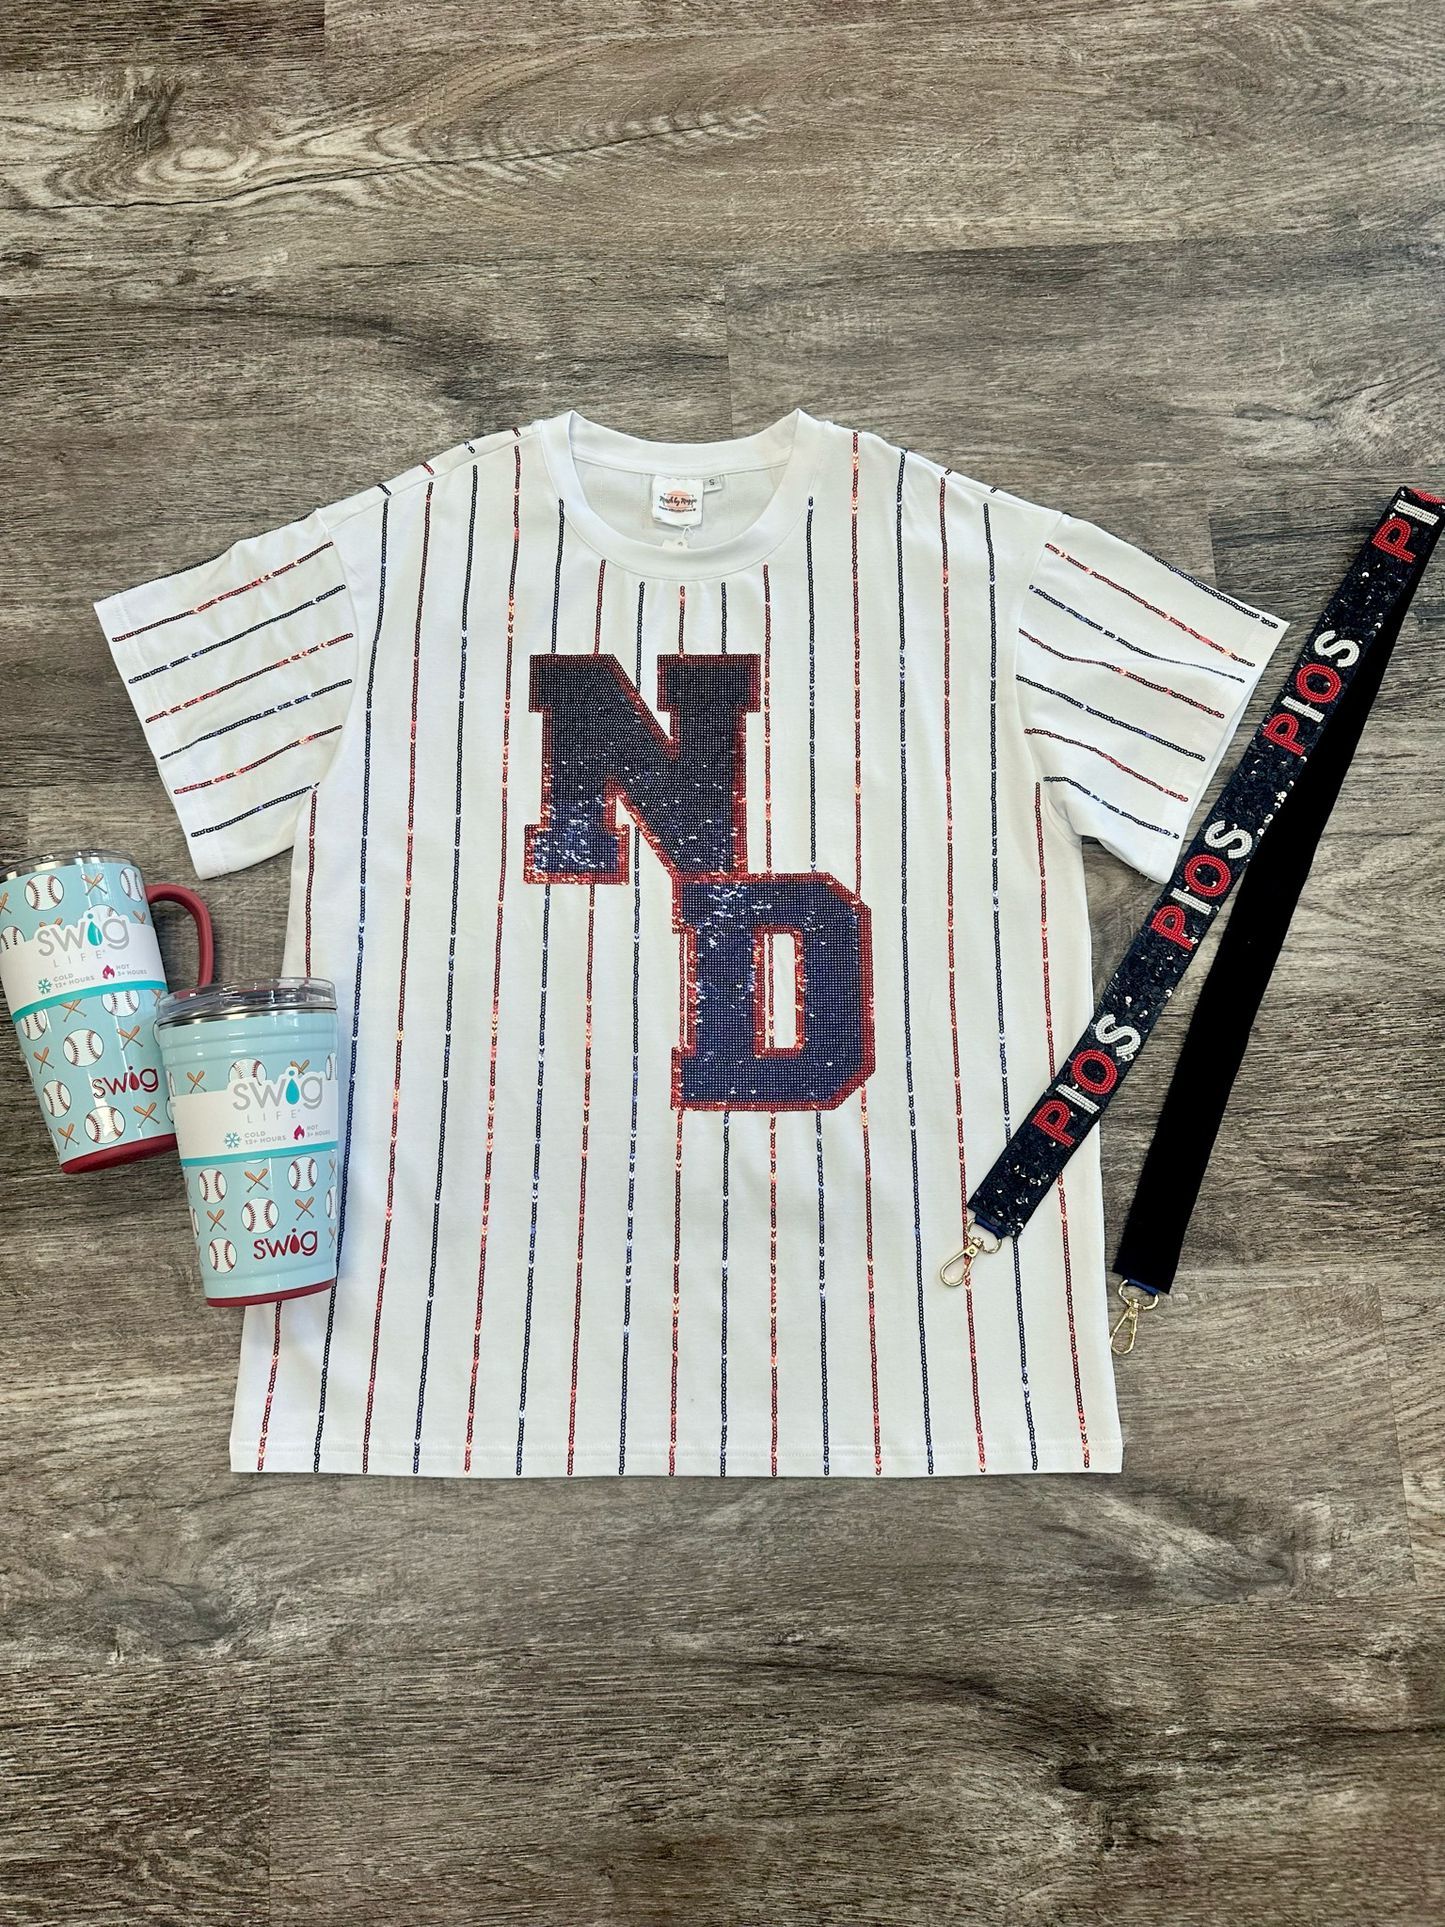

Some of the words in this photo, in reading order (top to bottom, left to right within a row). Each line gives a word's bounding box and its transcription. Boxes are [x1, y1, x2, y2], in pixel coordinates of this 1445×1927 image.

[708, 478, 715, 486] S
[1262, 629, 1360, 756] PIOS
[1151, 820, 1253, 951] PIOS
[37, 913, 130, 957] swig
[53, 950, 103, 968] LIFE
[53, 973, 74, 982] COLD
[54, 981, 67, 989] 12+
[69, 975, 95, 985] HOURS
[92, 1065, 159, 1099] swig
[232, 1070, 323, 1110] swig
[1031, 1013, 1141, 1148] PIOS
[246, 1109, 298, 1124] LIFE
[244, 1131, 266, 1139] COLD
[260, 1135, 287, 1143] HOURS
[253, 1228, 318, 1260] swig
